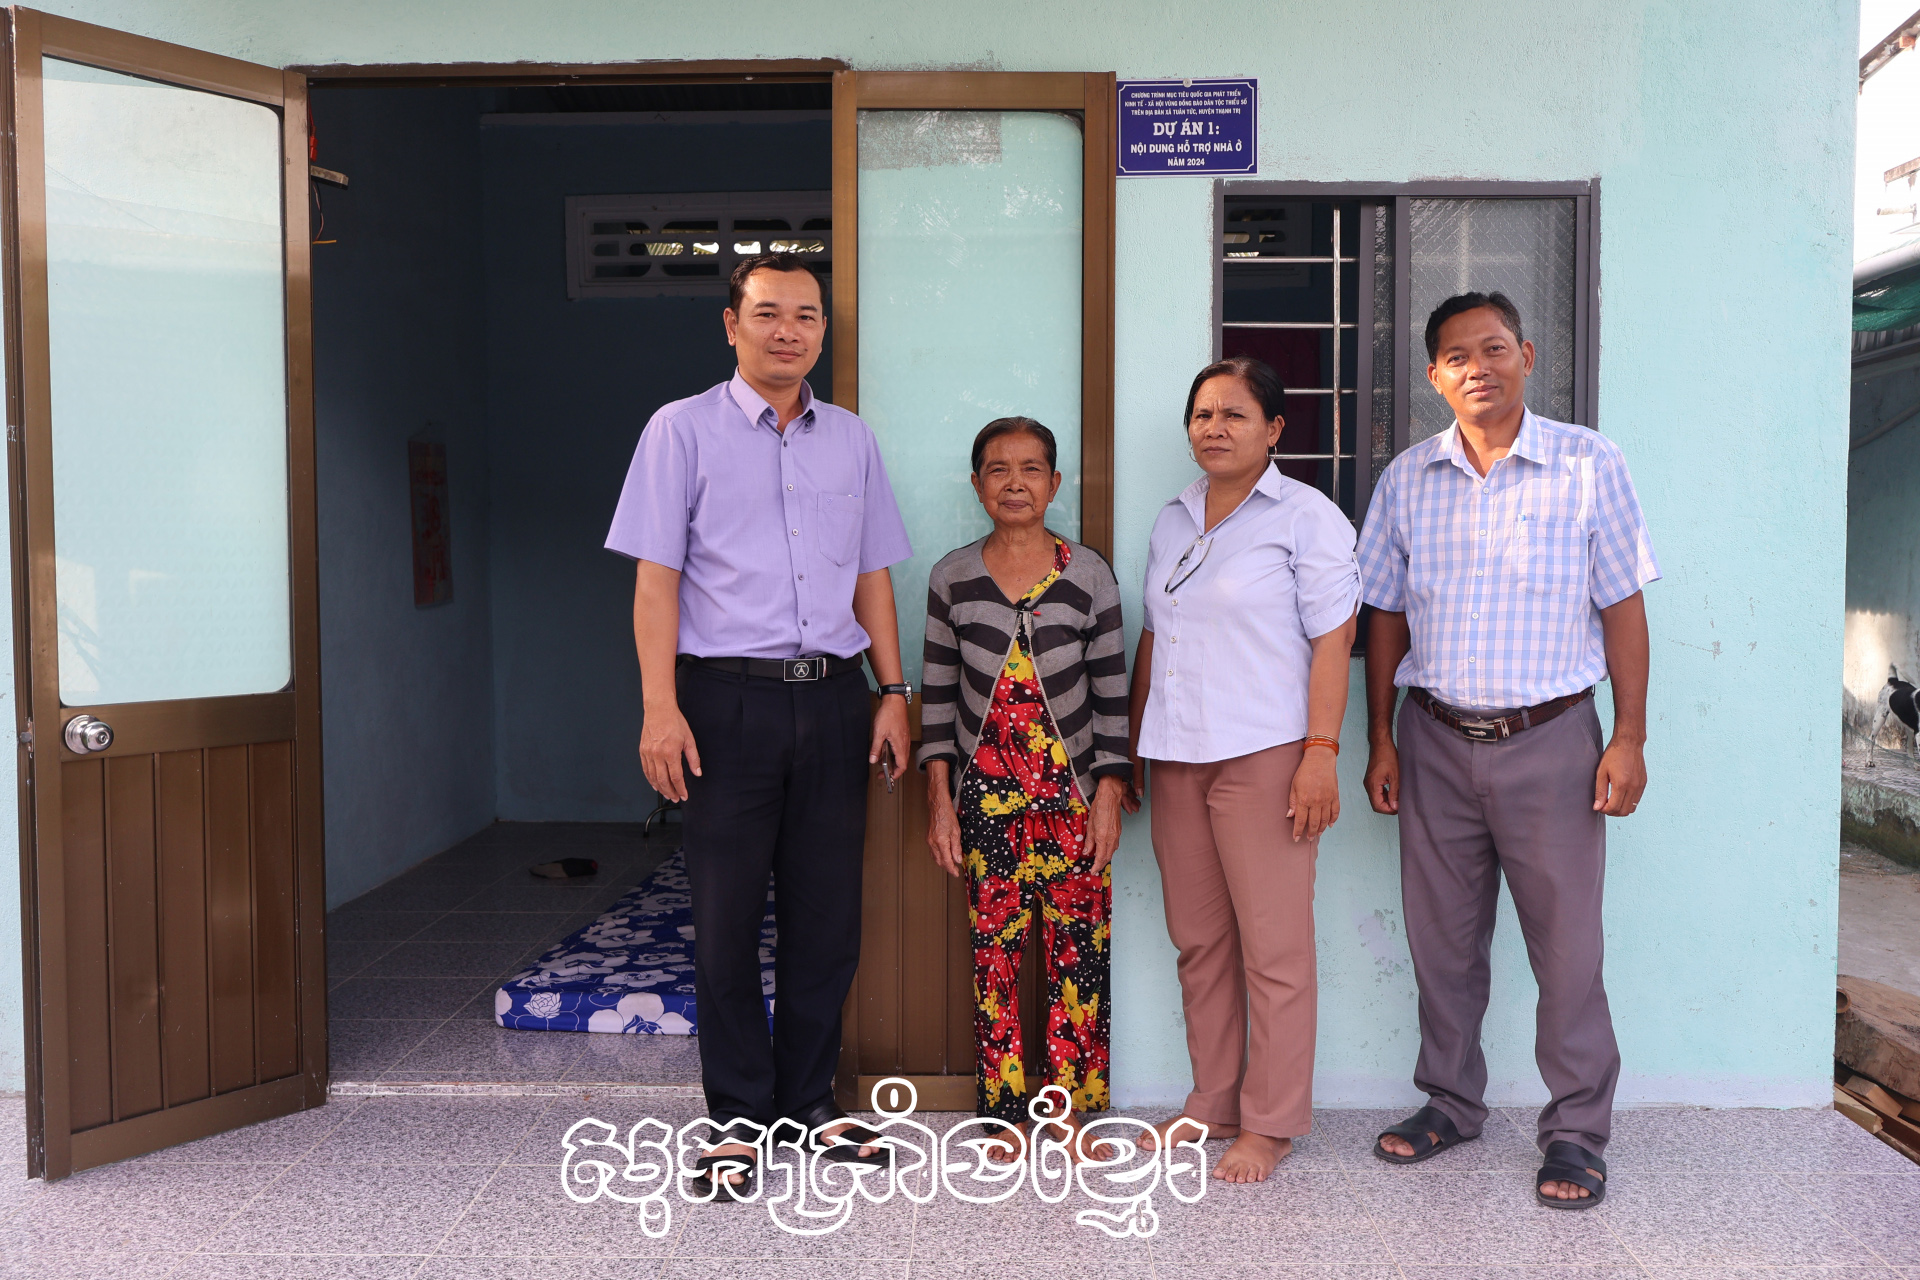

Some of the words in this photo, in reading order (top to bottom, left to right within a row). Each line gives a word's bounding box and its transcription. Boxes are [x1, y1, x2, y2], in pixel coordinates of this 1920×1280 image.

[1178, 90, 1189, 98] TIÊU
[1190, 90, 1203, 98] QUỐC
[1227, 88, 1241, 97] TRIỂN
[1137, 99, 1143, 107] TẾ
[1215, 98, 1224, 106] TỘC
[1241, 97, 1247, 105] SỐ
[1153, 121, 1178, 138] DỰ
[1180, 118, 1203, 135] ÁN
[1208, 122, 1220, 135] 1:
[1131, 142, 1146, 156] NỘI
[1149, 143, 1174, 153] DUNG
[1178, 139, 1190, 152] HỖ
[1193, 141, 1211, 154] TRỢ
[1214, 140, 1233, 152] NHÀ
[1235, 139, 1242, 152] Ở
[1168, 156, 1184, 166] NĂM
[1187, 158, 1205, 166] 2024
